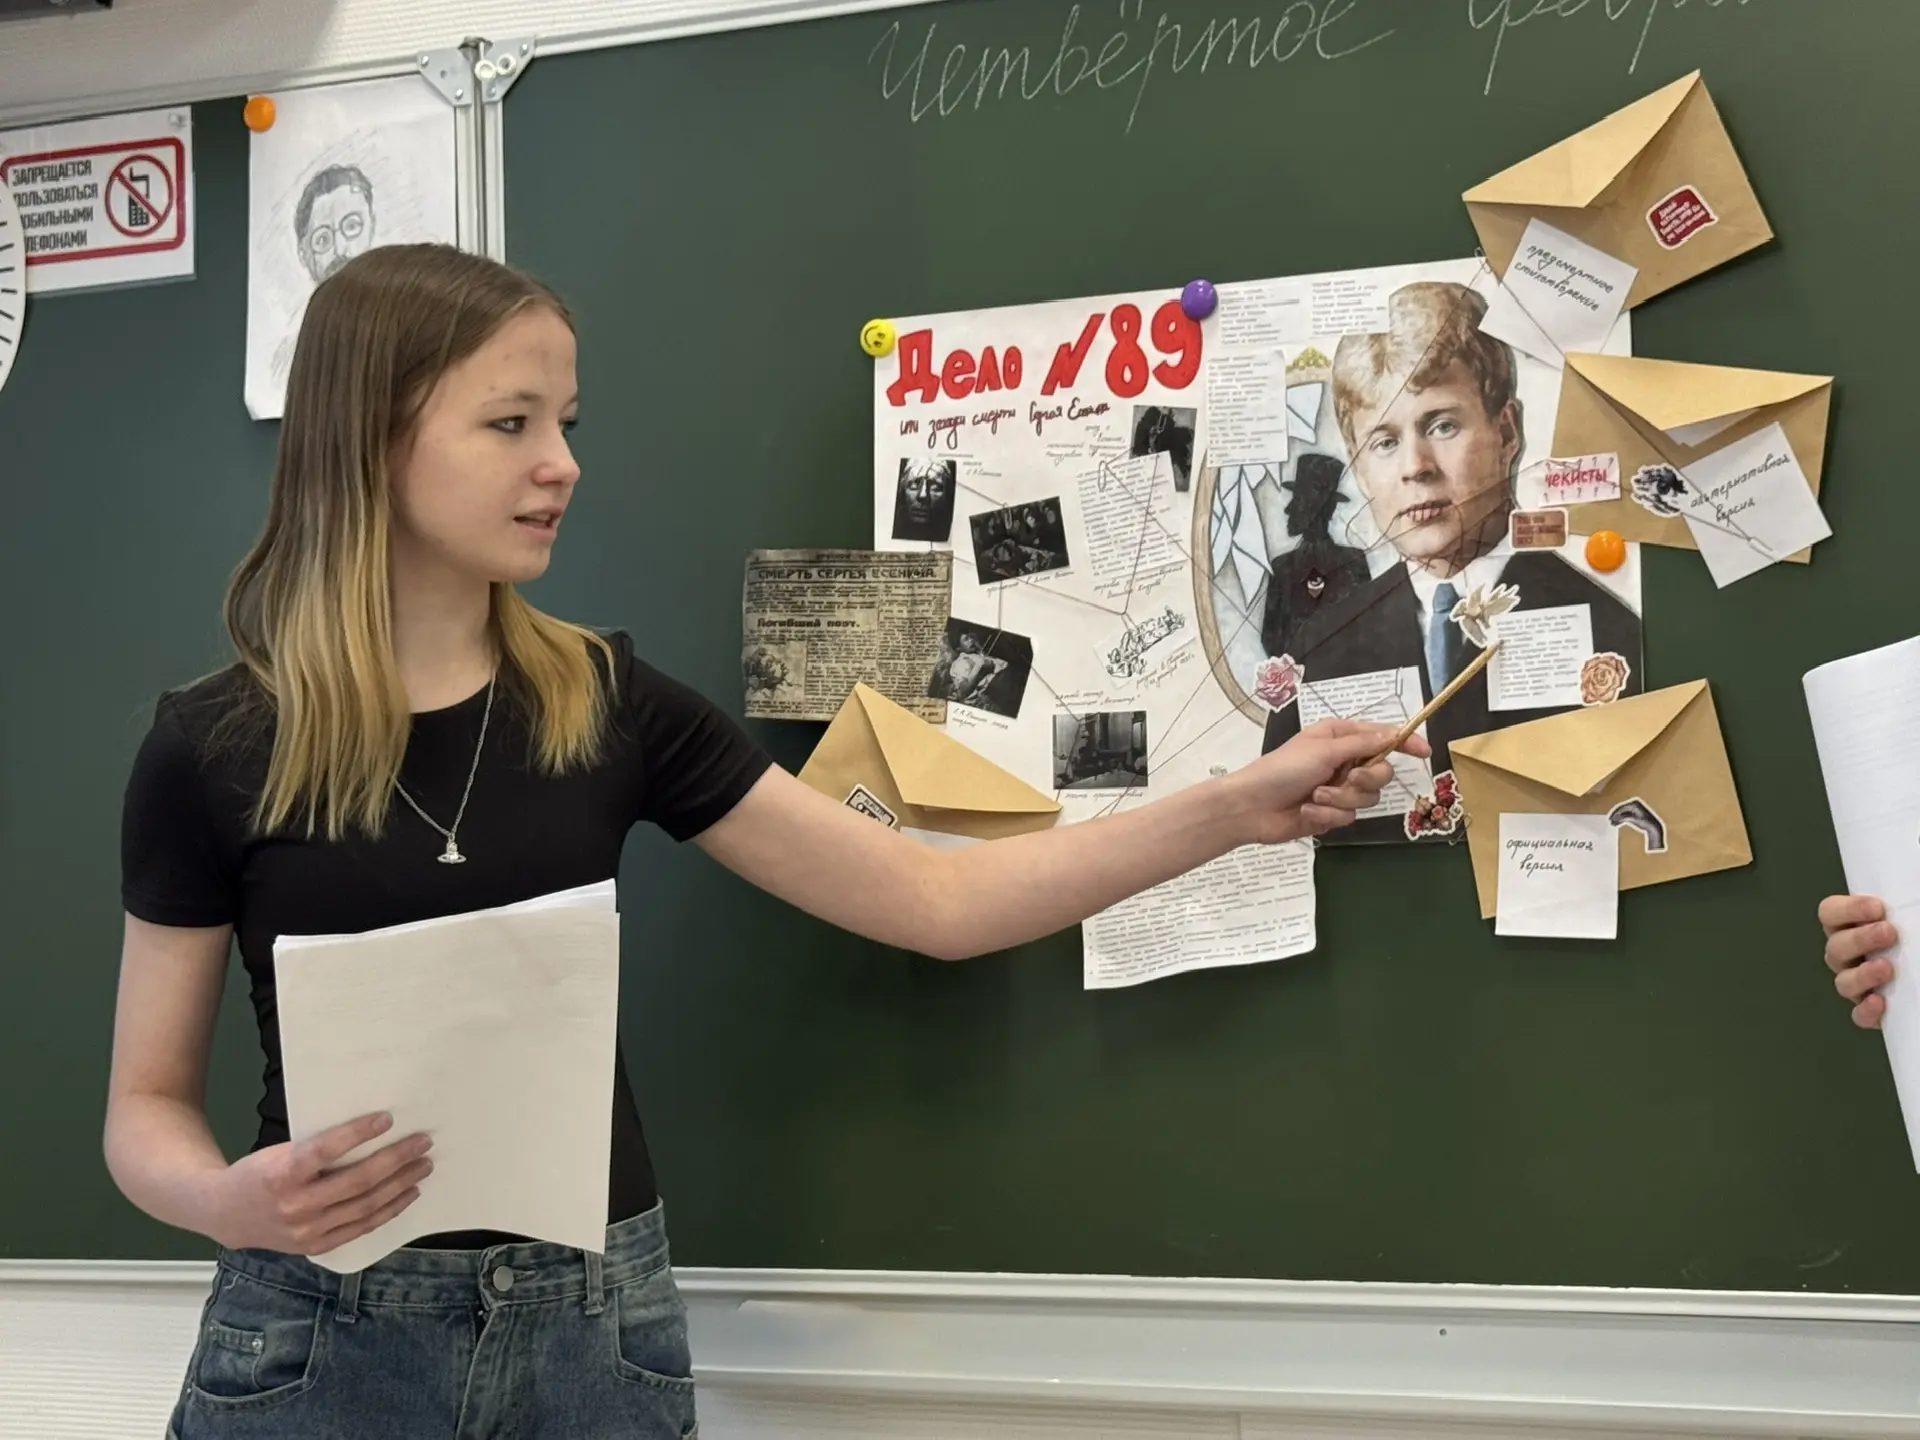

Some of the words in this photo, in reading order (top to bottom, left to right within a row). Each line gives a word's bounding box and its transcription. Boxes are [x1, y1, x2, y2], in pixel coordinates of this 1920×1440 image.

[12, 159, 92, 186] ЗАПРЕЩАЕТСЯ
[25, 229, 88, 252] ЛЕФОНАМИ
[886, 328, 1023, 407] Дело
[1715, 495, 1756, 529] версия
[757, 568, 812, 580] СМЕРТЬ
[817, 568, 867, 580] СЕРГЕЯ
[1506, 838, 1594, 860] официальная
[1519, 853, 1565, 879] версия
